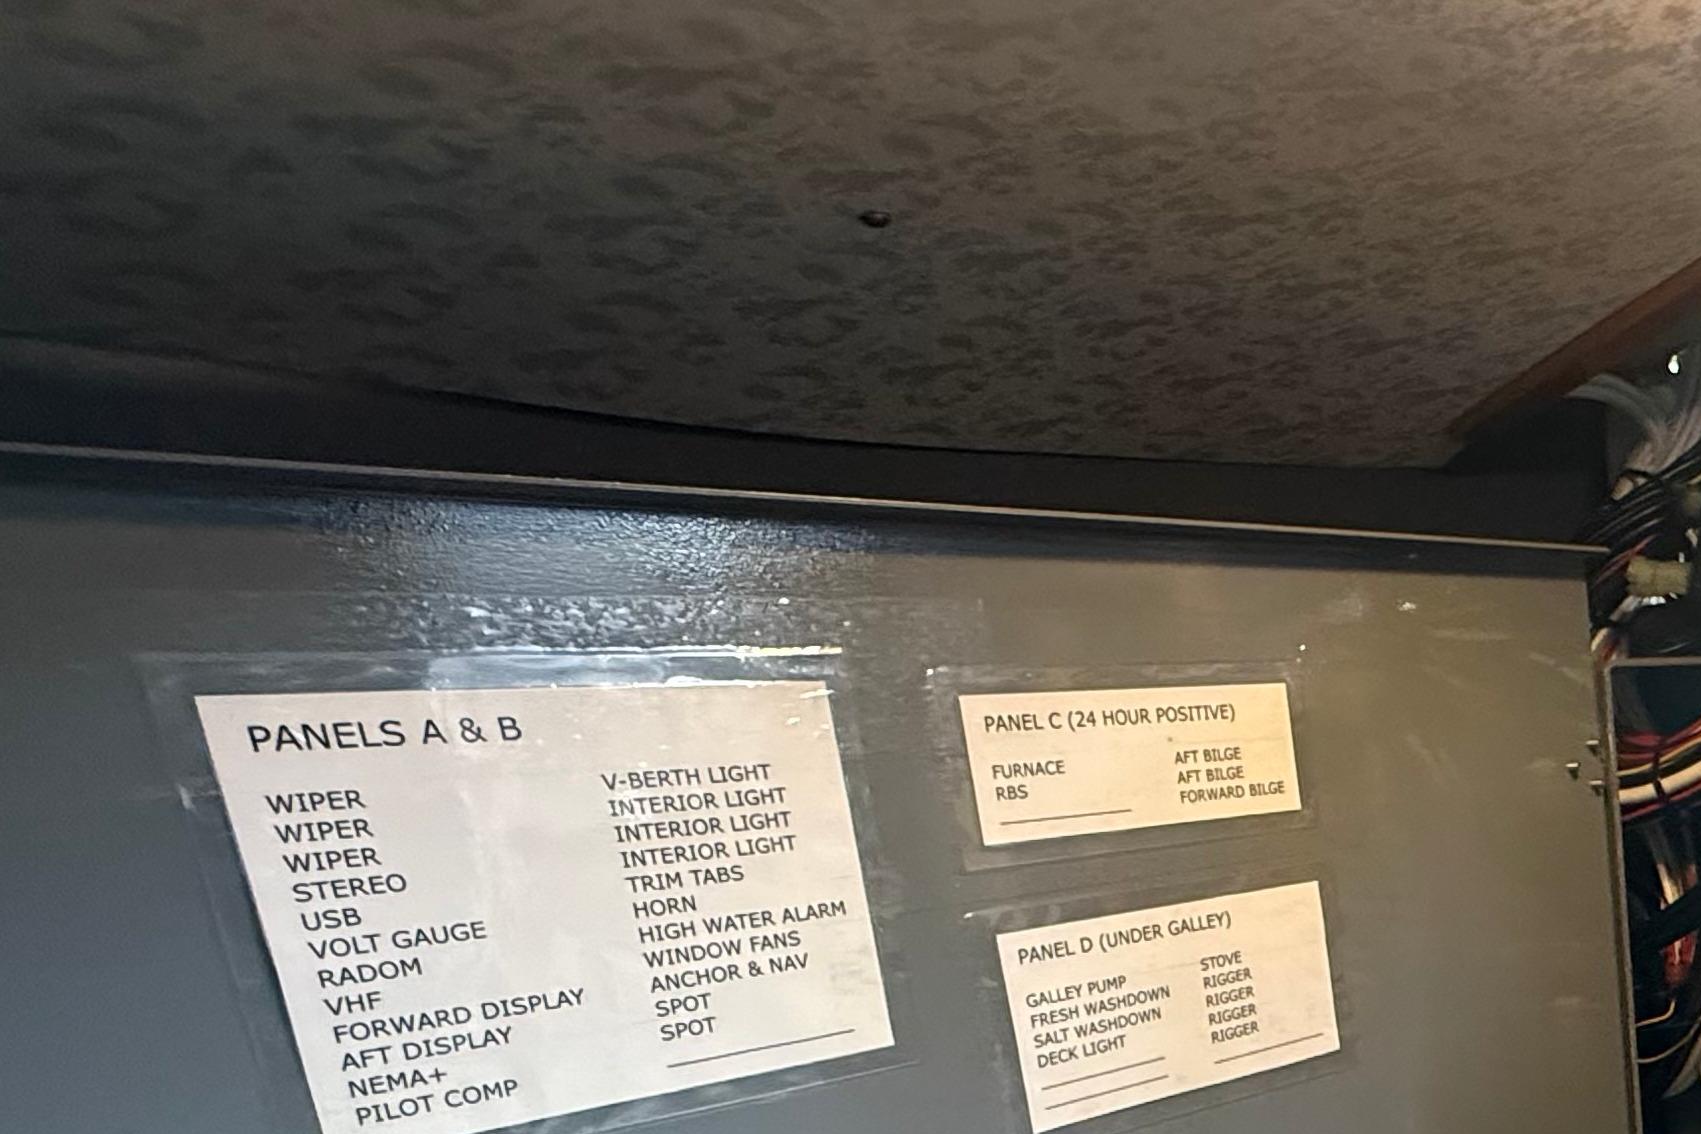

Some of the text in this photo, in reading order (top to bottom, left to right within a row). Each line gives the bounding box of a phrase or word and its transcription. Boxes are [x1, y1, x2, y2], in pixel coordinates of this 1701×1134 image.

[983, 703, 1236, 733] PANEL C (24 HOUR POSITIVE)
[247, 716, 522, 753] PANELS A & B
[991, 759, 1066, 780] FURNACE
[1174, 746, 1242, 765] AFT BILGE
[600, 763, 771, 791] V-BERTH LIGHT
[1177, 765, 1245, 785] AFT BILGE
[265, 789, 366, 815] WIPER
[607, 786, 786, 817] INTERIOR LIGHT
[995, 783, 1029, 801] RBS
[1179, 780, 1285, 804] FORWARD BILGE
[273, 818, 374, 844] WIPER
[613, 810, 791, 843] INTERIOR LIGHT
[282, 847, 382, 874] WIPER
[620, 834, 796, 869] INTERIOR LIGHT
[292, 873, 407, 903] STEREO
[624, 864, 745, 893] TRIM TABS
[300, 907, 362, 932] USB
[632, 895, 697, 919] HORN
[638, 900, 847, 944] HIGH WATER ALARM
[307, 920, 487, 960] VOLT GAUGE
[642, 930, 801, 968] WINDOW FANS
[1017, 910, 1232, 965] PANEL D (UNDER GALLEY)
[317, 957, 423, 989] RADOM
[650, 952, 808, 994] ANCHOR & NAV
[1199, 950, 1242, 972] STOVE
[1025, 975, 1127, 1008] GALLEY PUMP
[1202, 967, 1253, 990] RIGGER
[322, 990, 381, 1016] VHF
[654, 992, 711, 1018] SPOT
[1030, 985, 1171, 1029] FRESH WASHDOWN
[1205, 985, 1255, 1008] RIGGER
[332, 988, 584, 1044] FORWARD DISPLAY
[660, 1016, 716, 1042] SPOT
[1033, 1007, 1162, 1049] SALT WASHDOWN
[1208, 1003, 1257, 1026] RIGGER
[1210, 1020, 1260, 1044] RIGGER
[341, 1025, 512, 1072] AFT DISPLAY
[1036, 1034, 1126, 1069] DECK LIGHT
[348, 1067, 447, 1099] NEMA+
[355, 1079, 518, 1126] PILOT COMP
